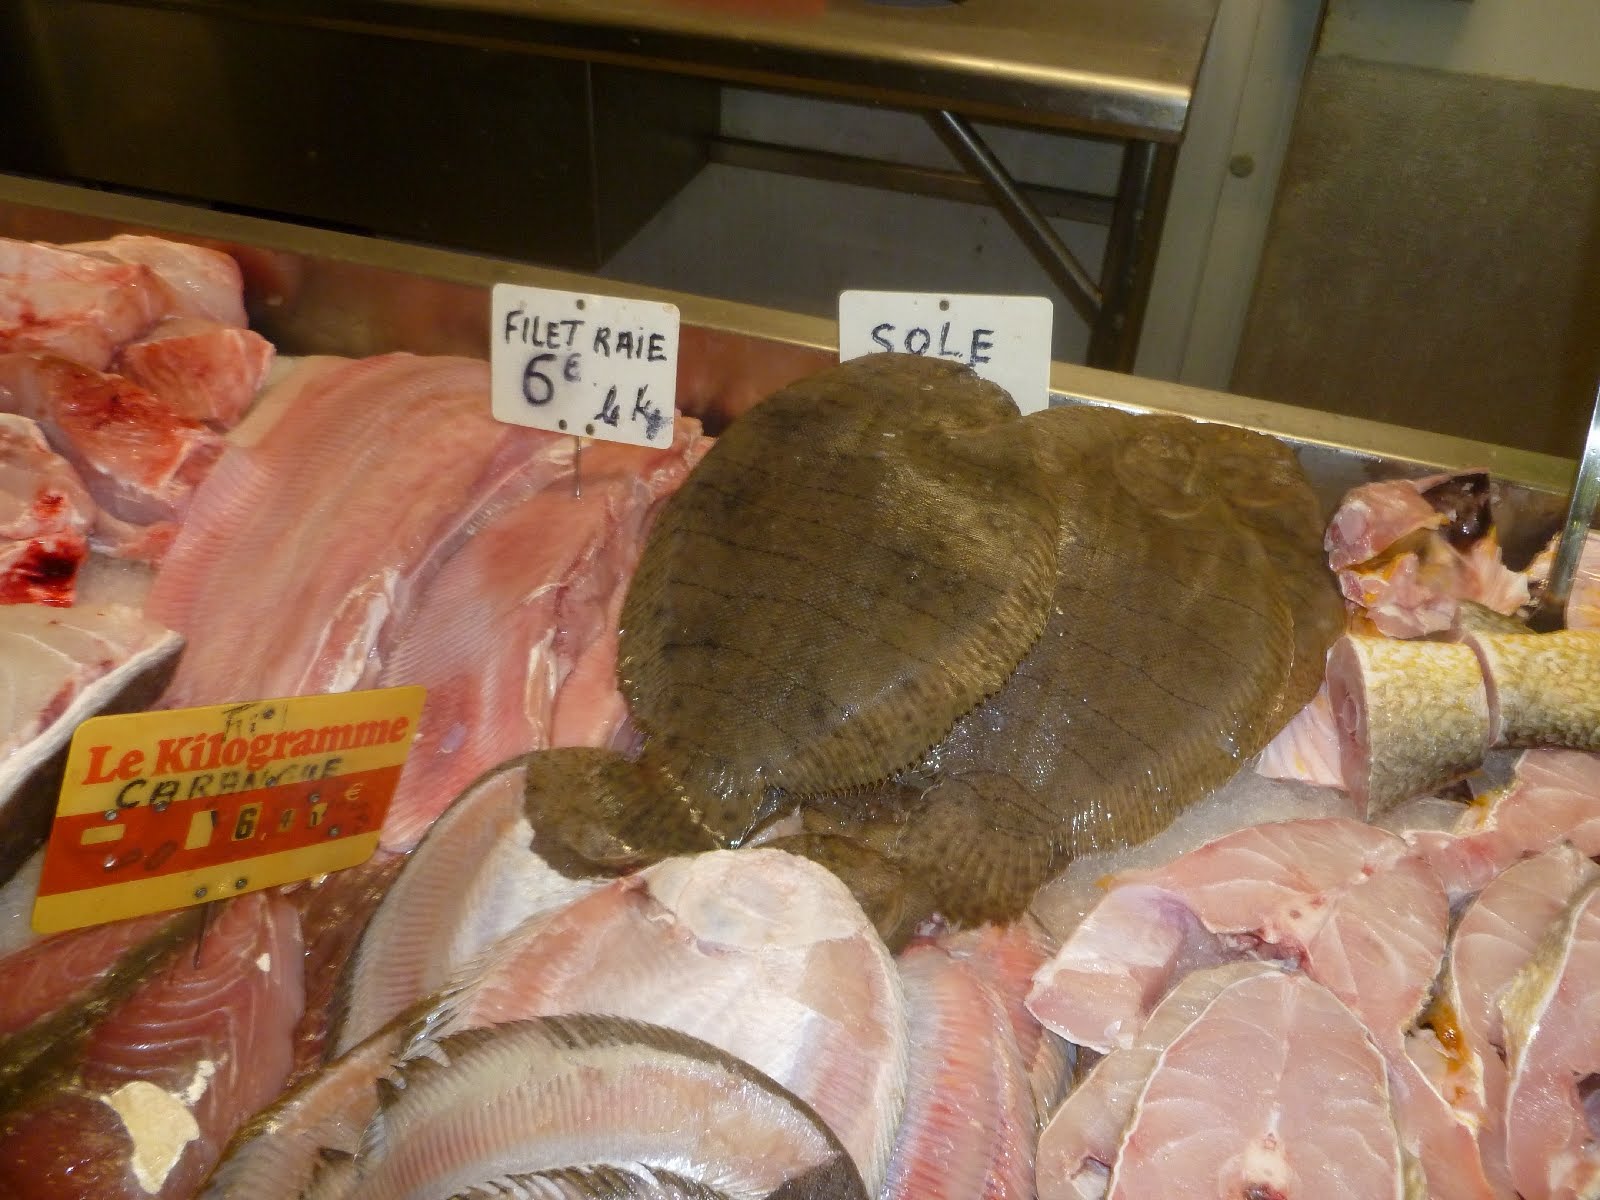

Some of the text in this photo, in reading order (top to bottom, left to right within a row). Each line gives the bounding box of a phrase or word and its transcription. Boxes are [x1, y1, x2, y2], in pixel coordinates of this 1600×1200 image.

[505, 309, 667, 361] FILET RAIE
[871, 321, 995, 368] SOLE
[82, 744, 145, 785] Le
[153, 714, 410, 777] Kilogramme
